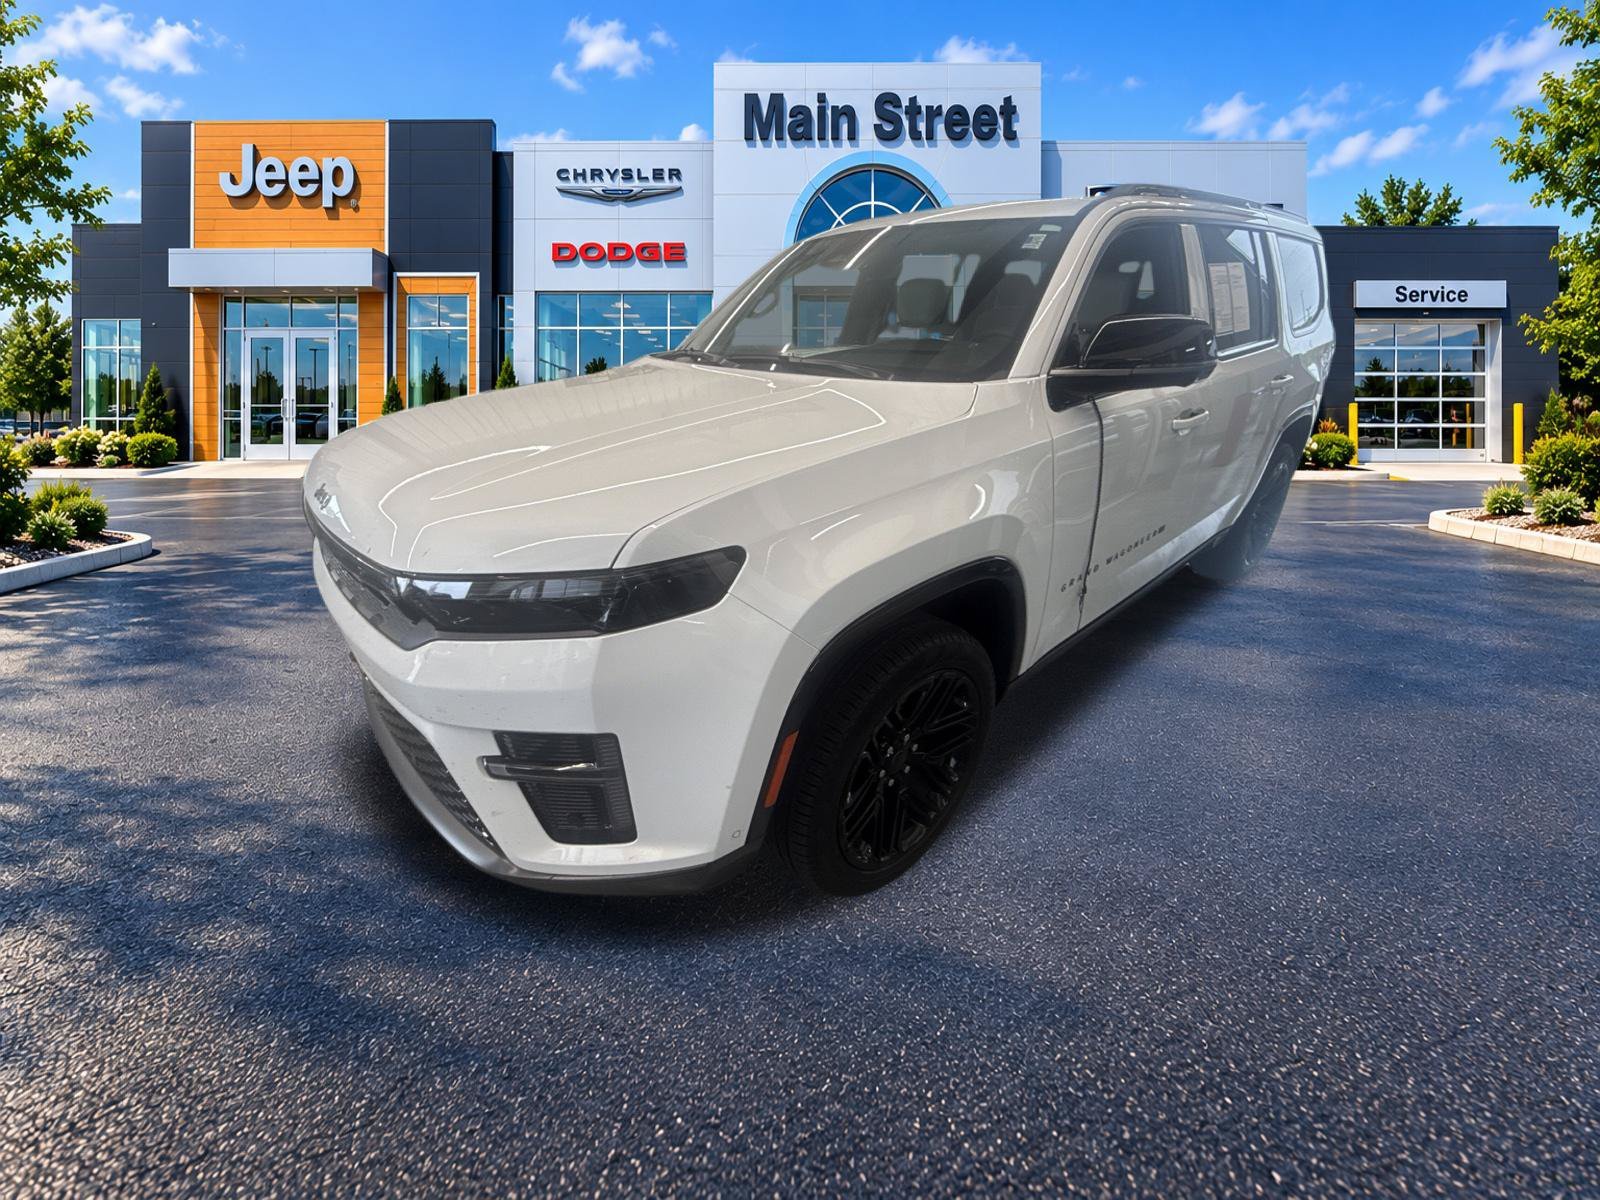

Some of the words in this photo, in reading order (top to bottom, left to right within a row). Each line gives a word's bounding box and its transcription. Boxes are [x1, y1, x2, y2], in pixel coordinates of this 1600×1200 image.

[744, 93, 856, 141] Main
[873, 92, 1018, 141] Street
[219, 143, 355, 208] Jeep
[556, 167, 683, 183] CHRYSLER
[551, 241, 686, 262] DODGE
[1395, 285, 1469, 303] Service
